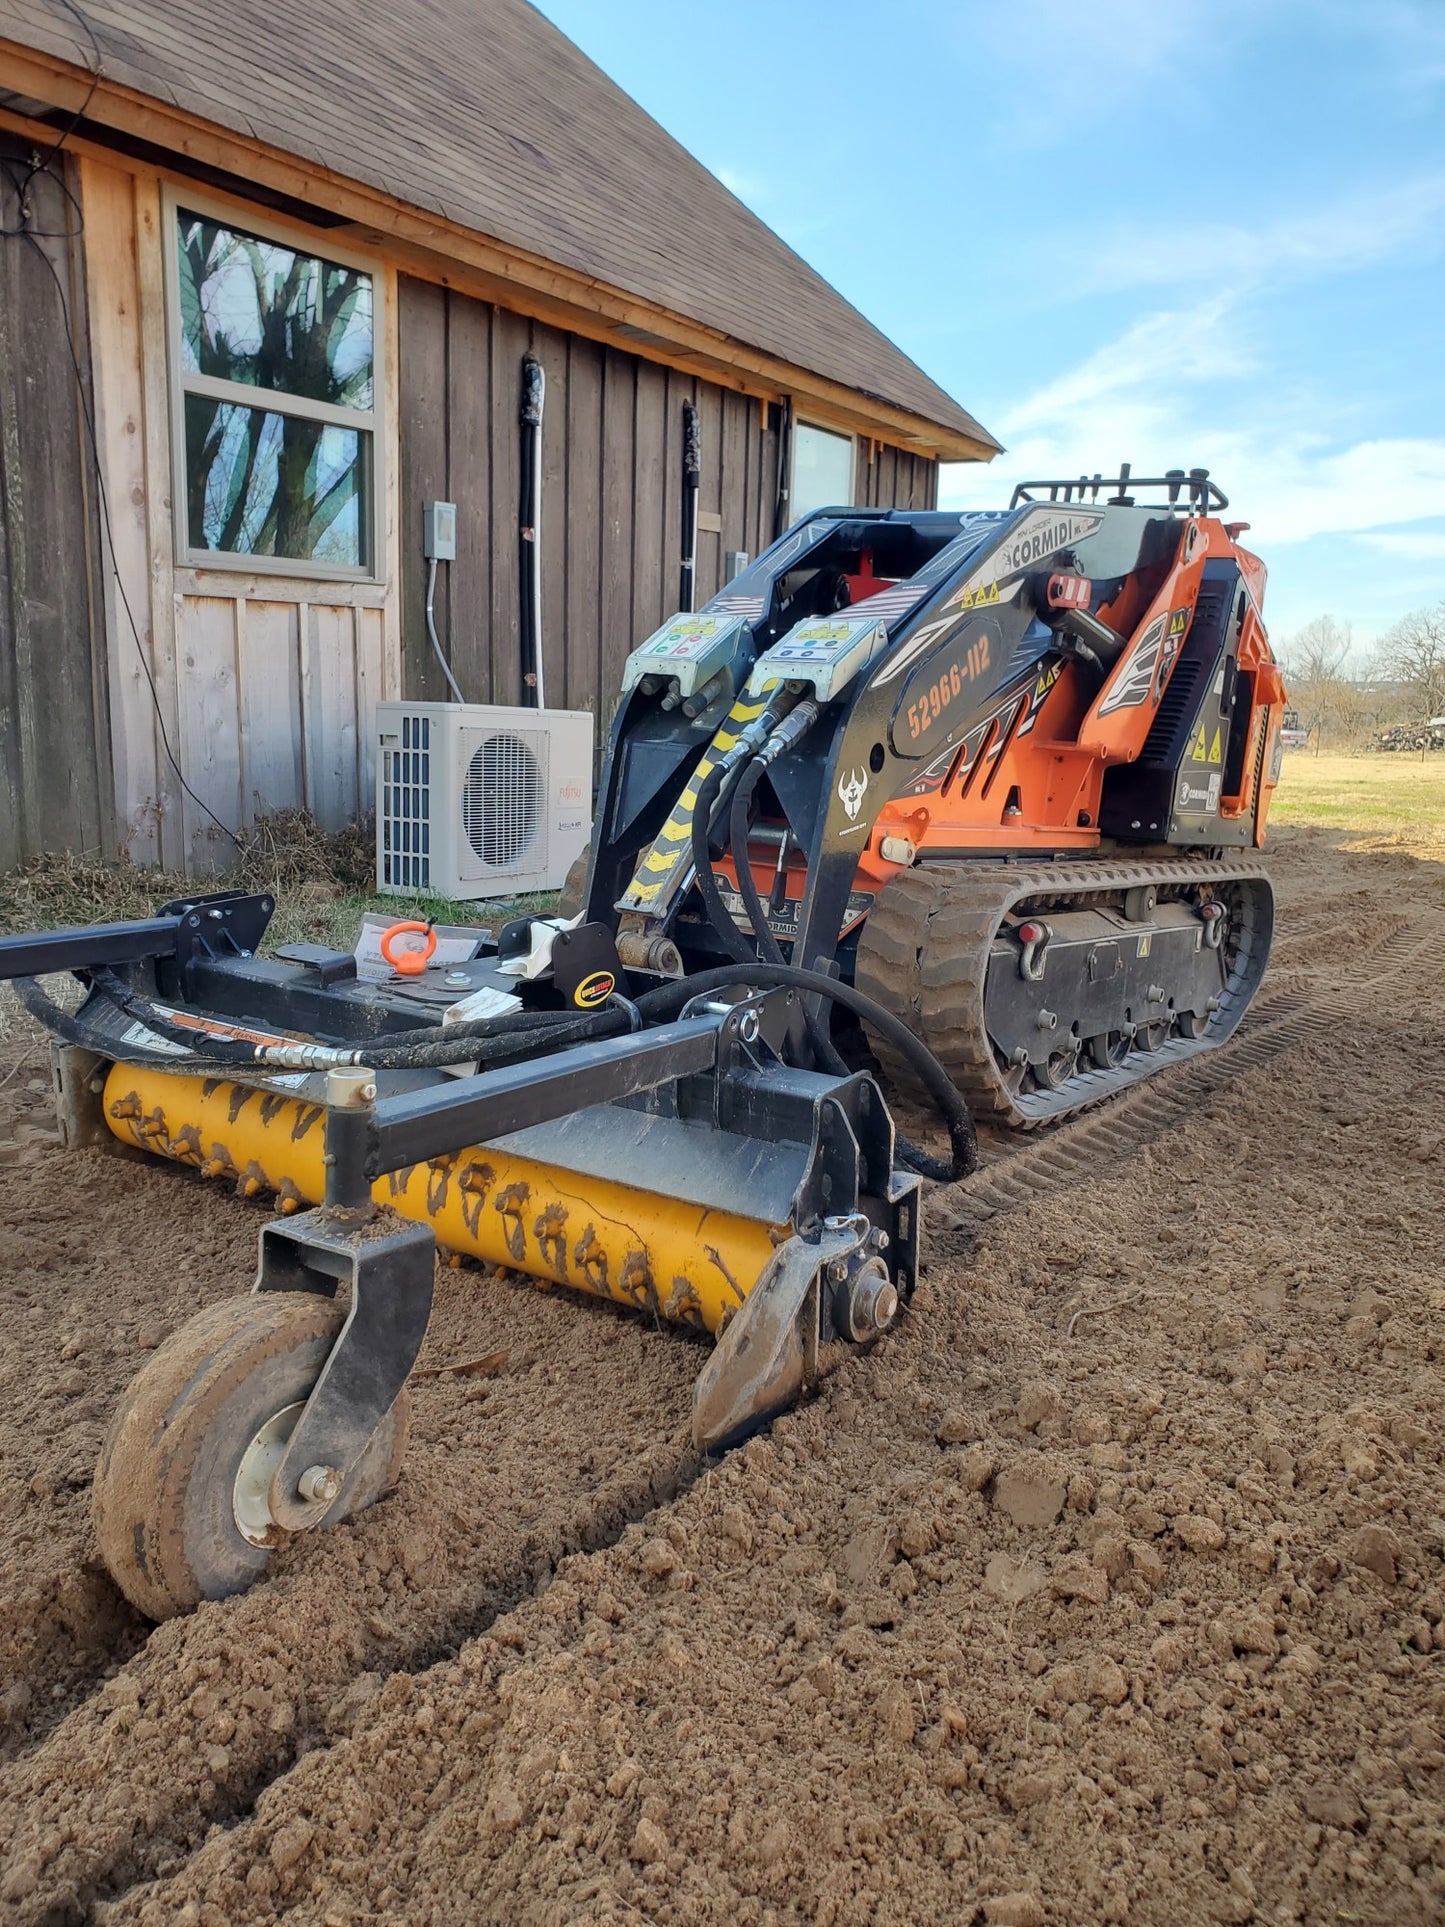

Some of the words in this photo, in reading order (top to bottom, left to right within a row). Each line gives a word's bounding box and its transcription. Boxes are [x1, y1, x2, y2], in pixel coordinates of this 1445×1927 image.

[1012, 519, 1072, 568] CORMIDI
[907, 634, 991, 739] 52966-112
[559, 785, 582, 800] FUJITSU
